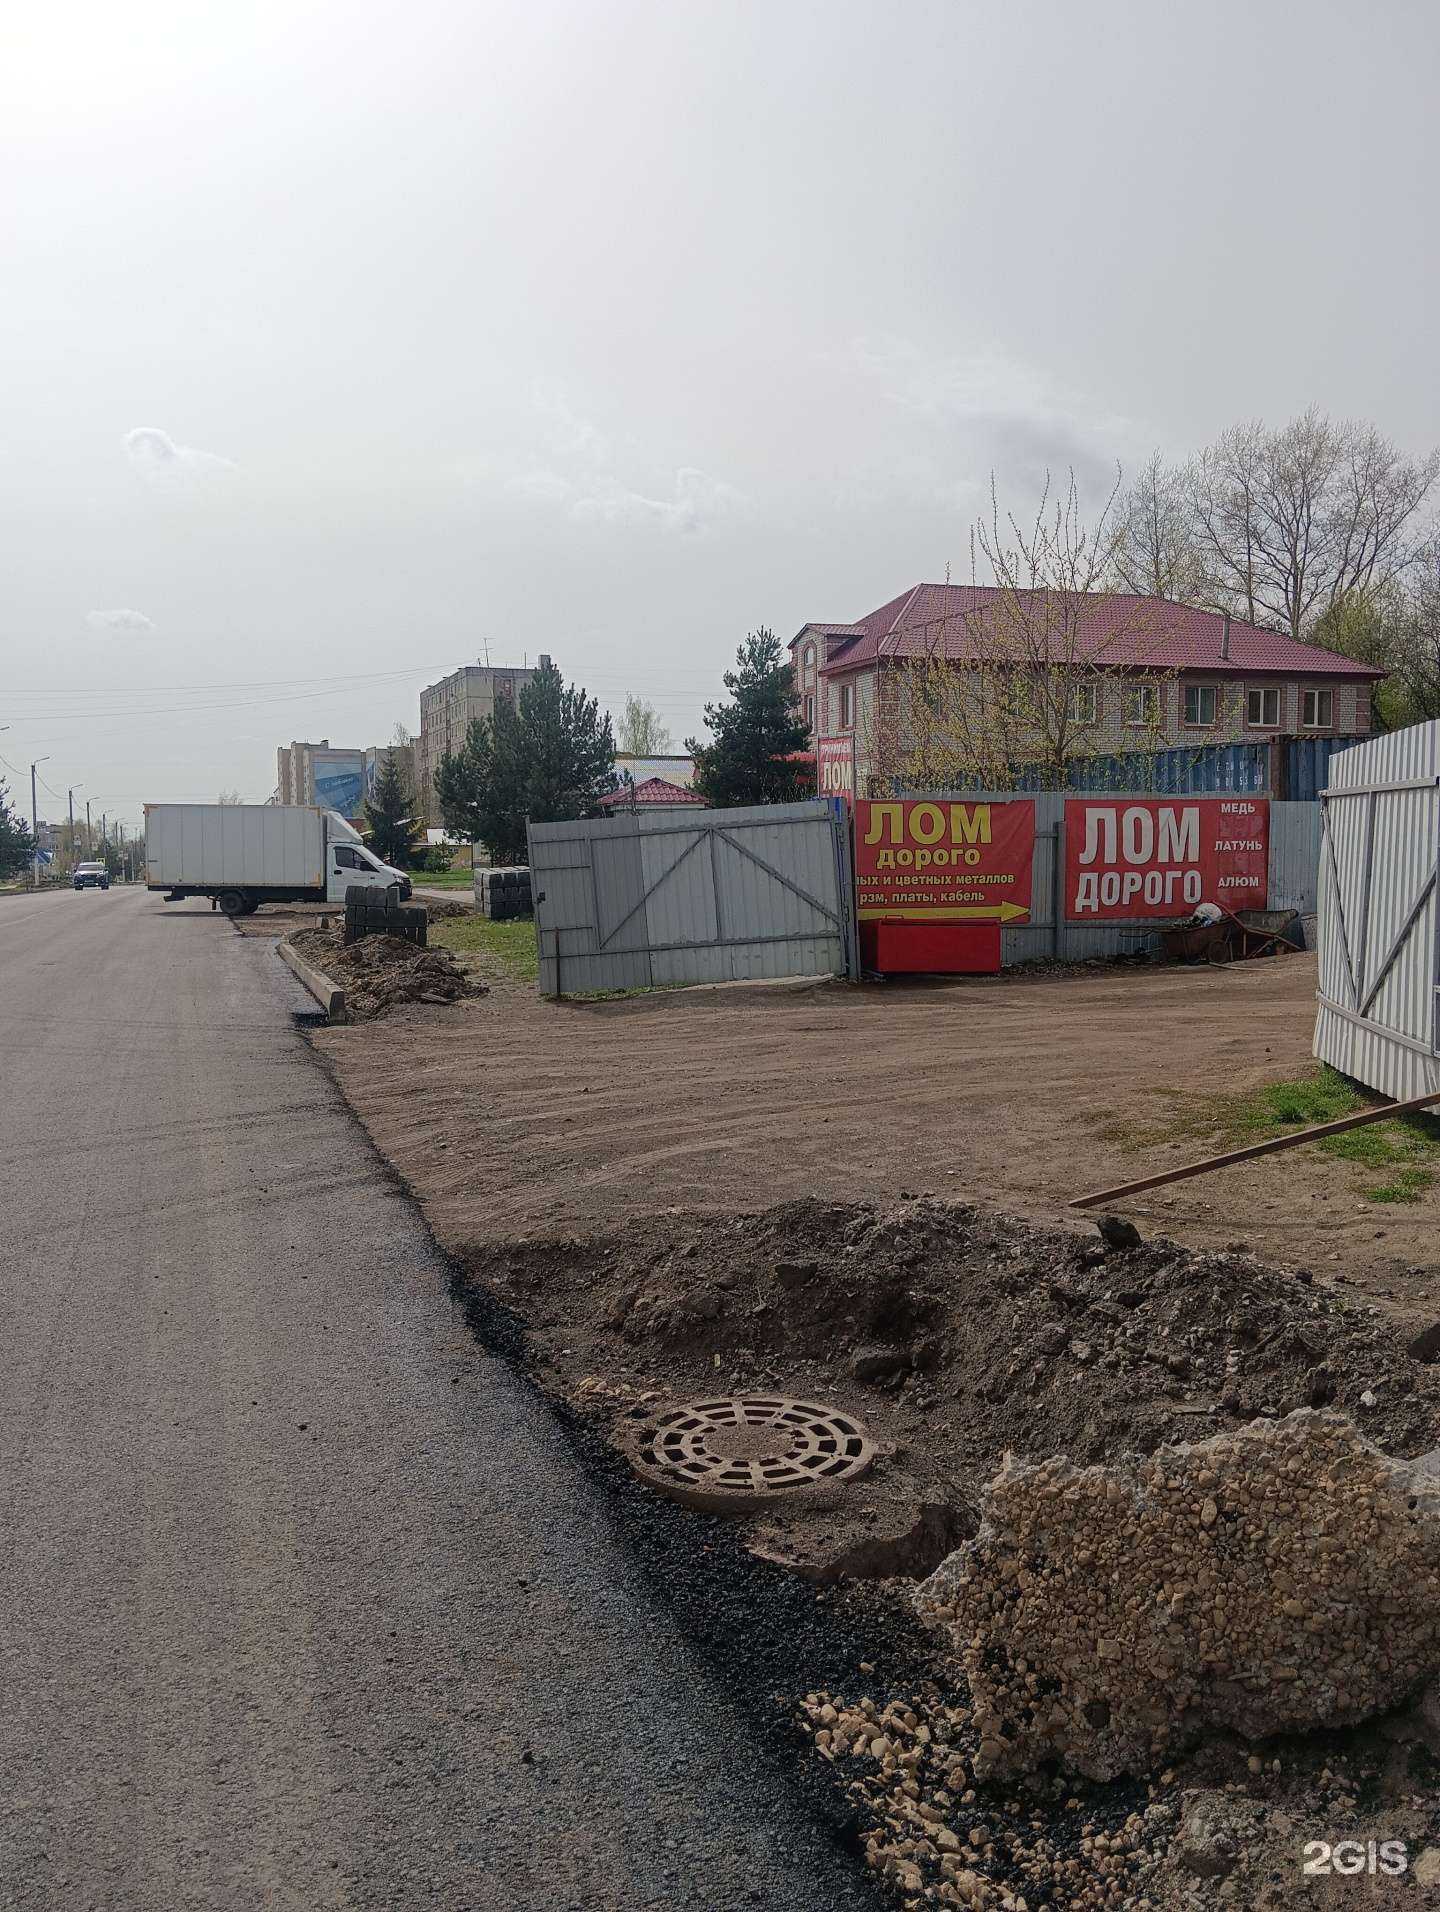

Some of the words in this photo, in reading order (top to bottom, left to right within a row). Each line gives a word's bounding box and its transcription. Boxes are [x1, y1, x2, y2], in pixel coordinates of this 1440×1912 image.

[823, 760, 852, 790] ЛОМ
[1221, 803, 1256, 815] МЕДЬ
[864, 802, 992, 845] ЛОМ
[1079, 806, 1200, 865] ЛОМ
[1214, 840, 1263, 852] ЛАТУНЬ
[876, 848, 982, 871] дорого
[883, 875, 892, 885] и
[895, 874, 952, 887] цветных
[956, 873, 1015, 885] металлов
[1217, 876, 1259, 889] АЛЮМ
[892, 891, 937, 904] платы,
[940, 889, 985, 902] кабель
[1074, 869, 1202, 913] ДОРОГО
